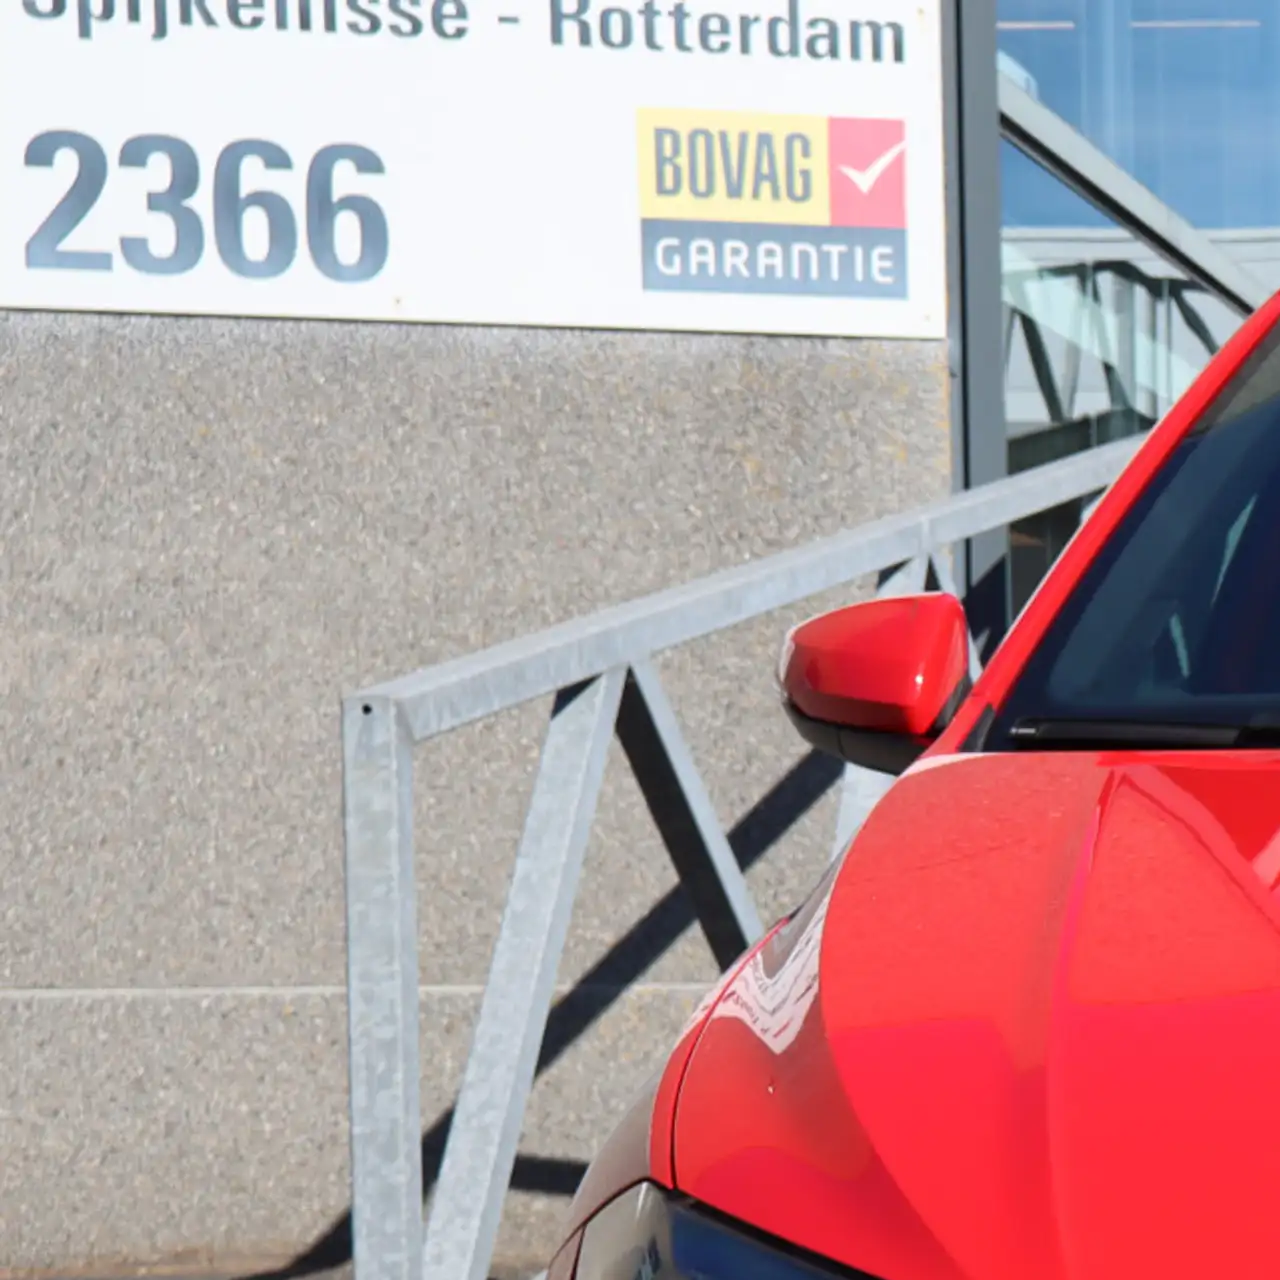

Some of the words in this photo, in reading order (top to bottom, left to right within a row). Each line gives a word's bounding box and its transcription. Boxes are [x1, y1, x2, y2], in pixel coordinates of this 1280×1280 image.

[549, 0, 905, 63] Rotterdam
[654, 127, 812, 203] BOVAG
[23, 129, 389, 282] 2366
[654, 237, 895, 284] GARANTIE
